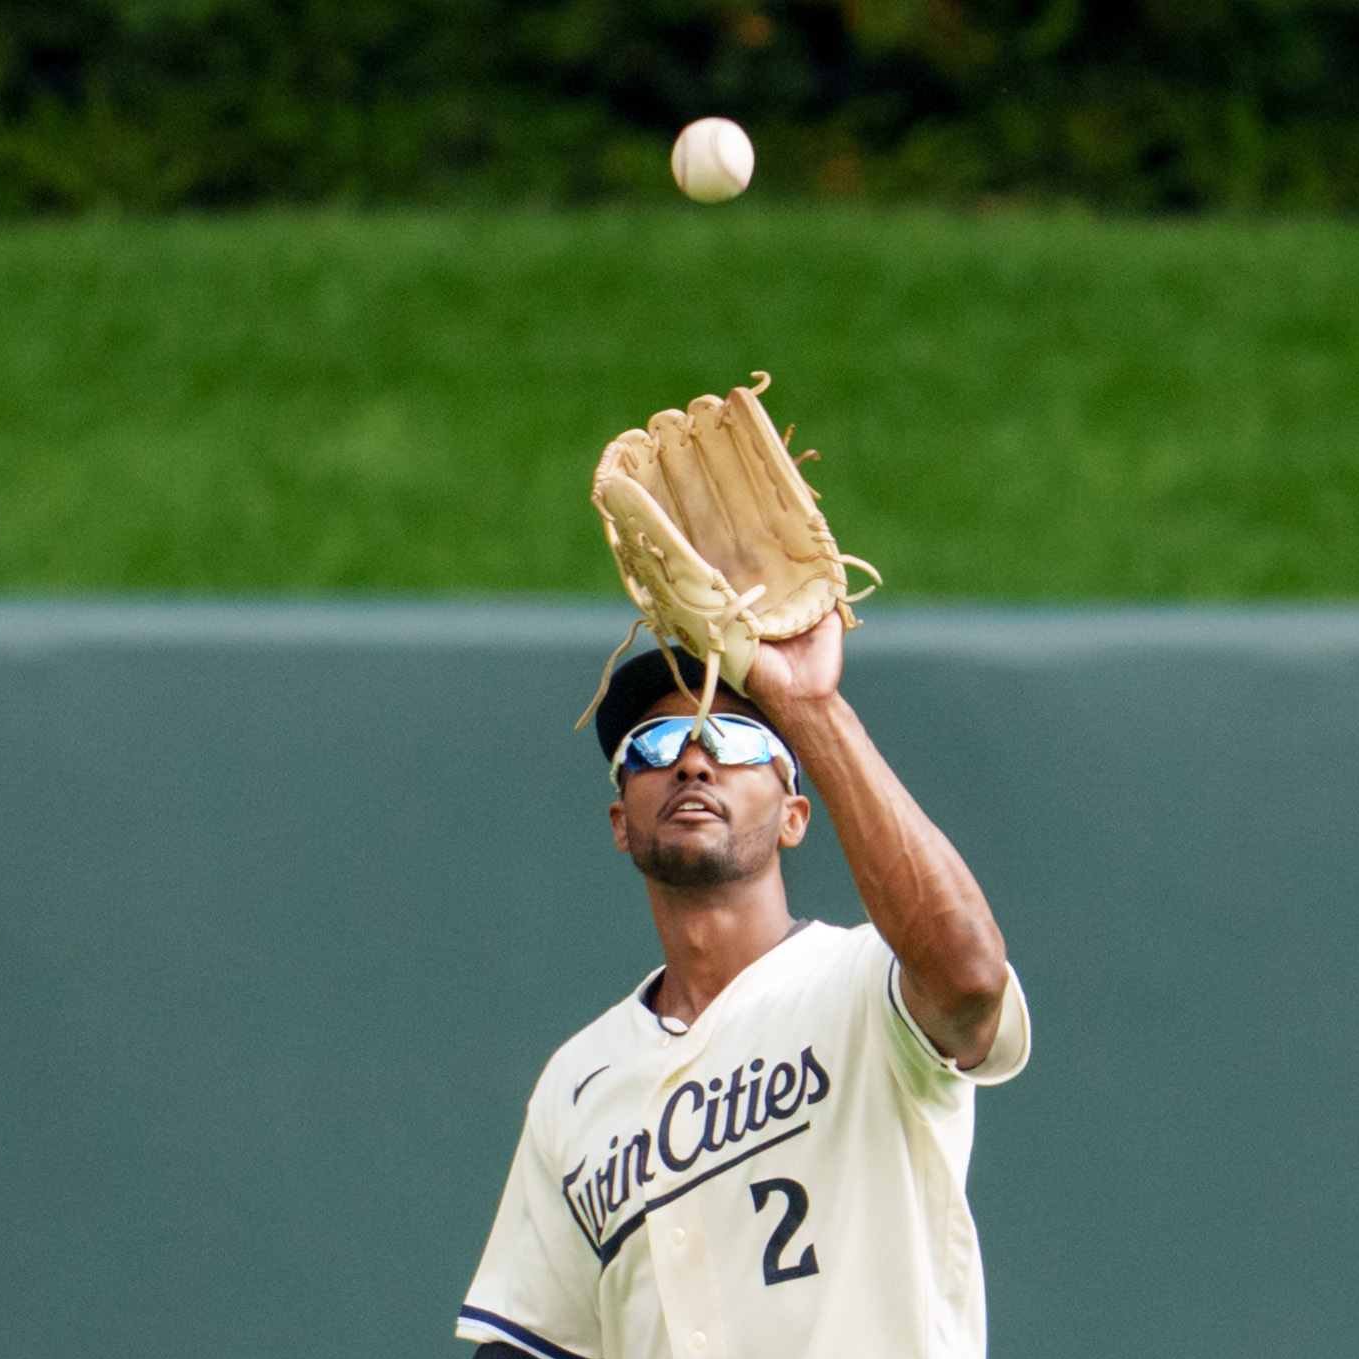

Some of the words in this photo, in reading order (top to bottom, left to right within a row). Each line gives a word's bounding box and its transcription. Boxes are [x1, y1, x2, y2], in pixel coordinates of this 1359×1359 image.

[562, 1128, 656, 1260] Twin
[657, 1045, 831, 1172] Cities
[749, 1177, 820, 1286] 2
